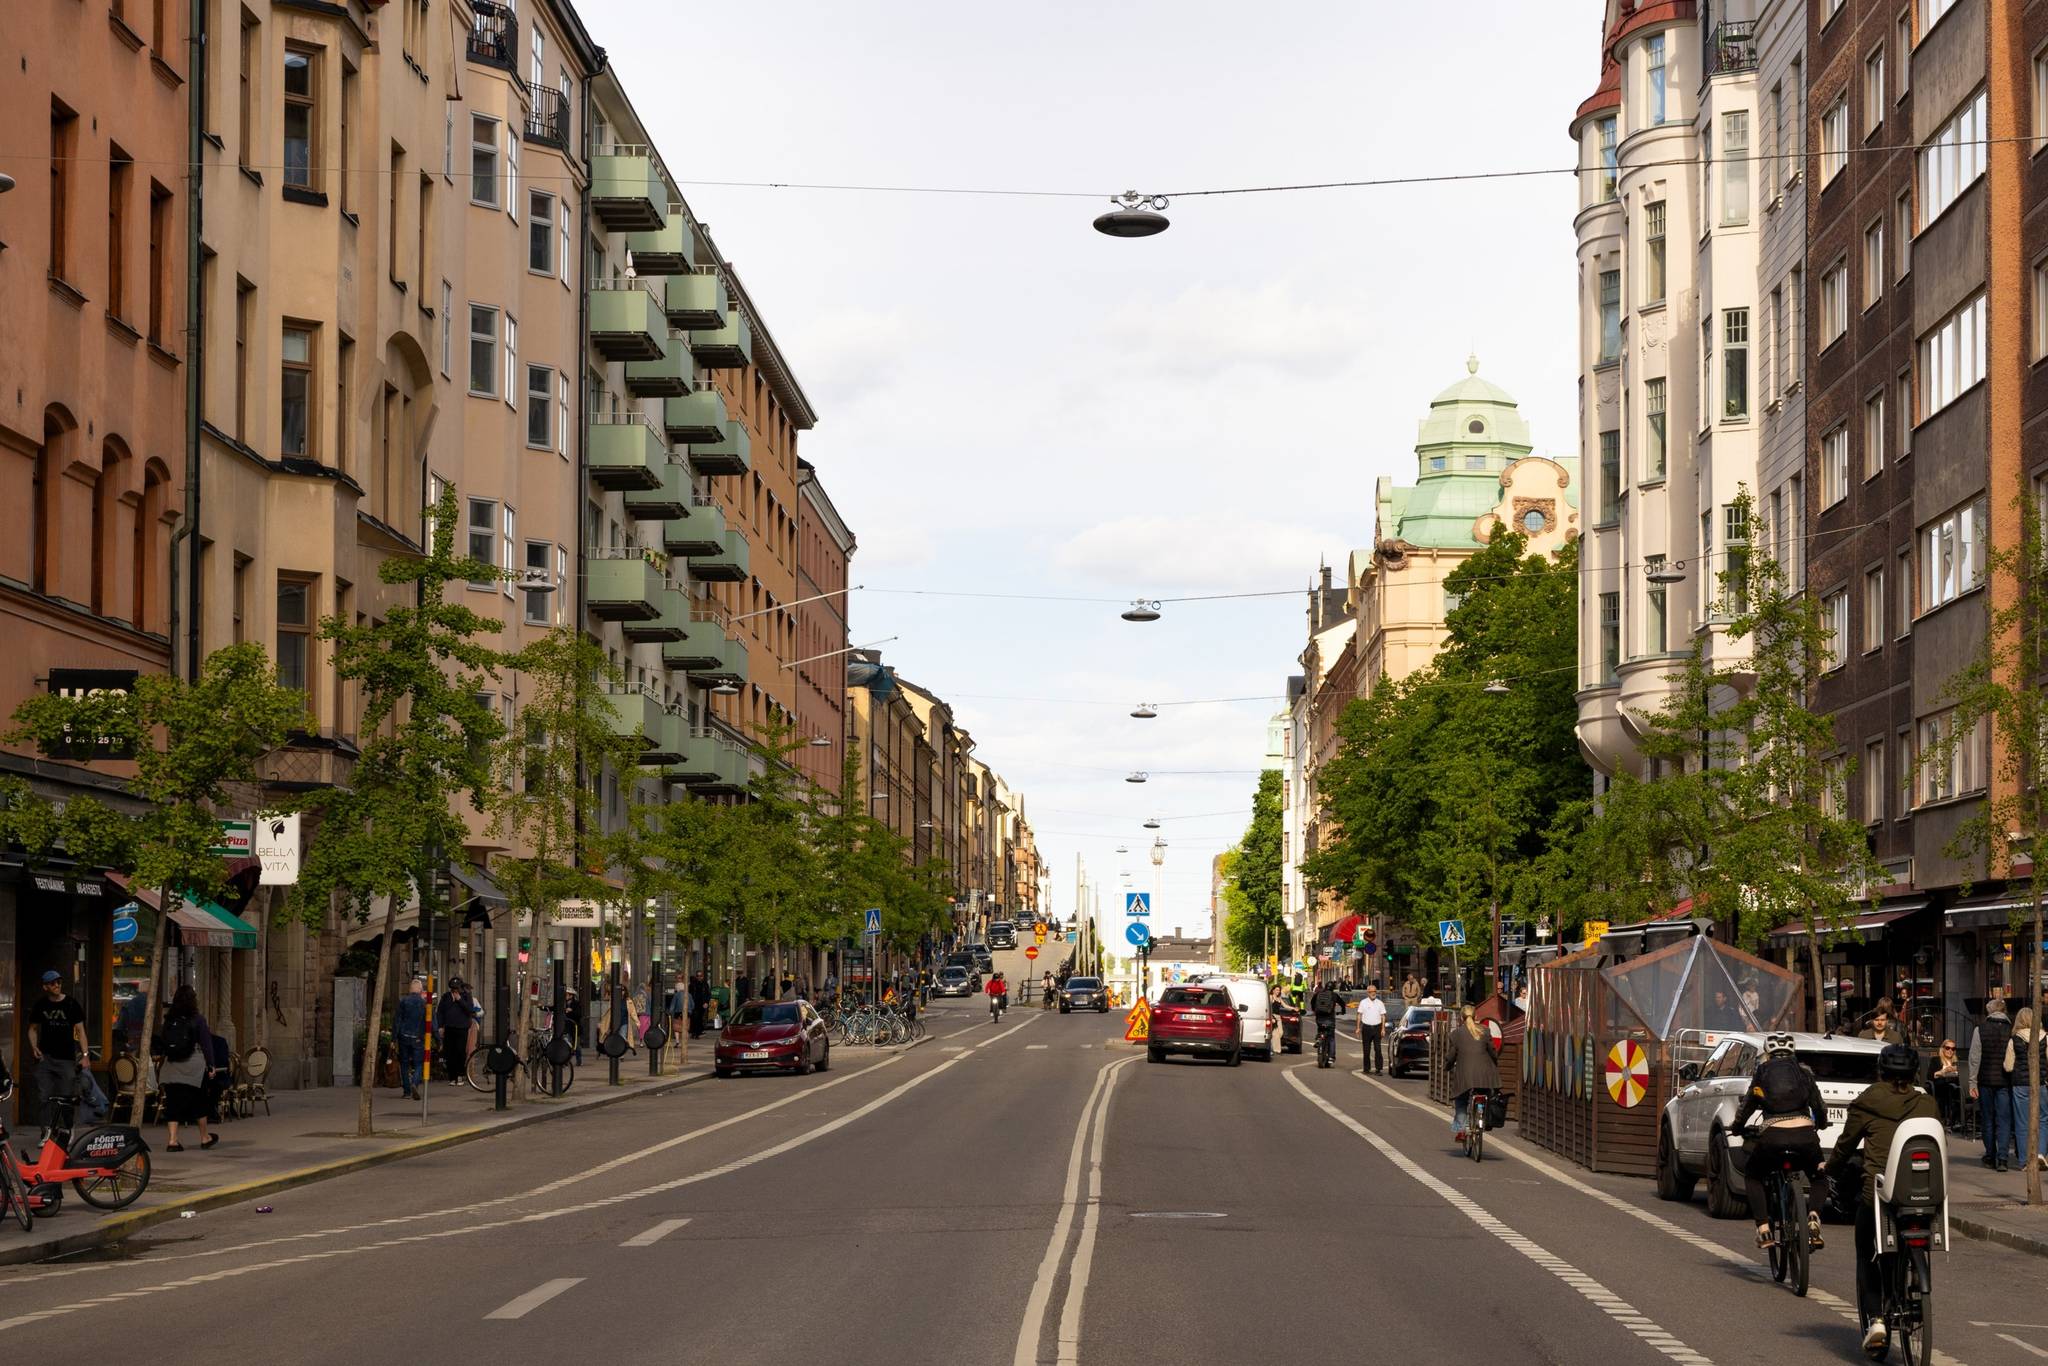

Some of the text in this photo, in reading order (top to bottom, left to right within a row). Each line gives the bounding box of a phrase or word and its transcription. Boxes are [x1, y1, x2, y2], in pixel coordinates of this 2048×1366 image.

[98, 736, 109, 744] 25
[228, 836, 248, 846] Pizza
[258, 847, 296, 858] BELLA
[263, 862, 290, 872] VITA
[94, 1134, 125, 1144] FÖRSTA
[86, 1142, 114, 1151] RESAN
[90, 1148, 119, 1158] GRATIS
